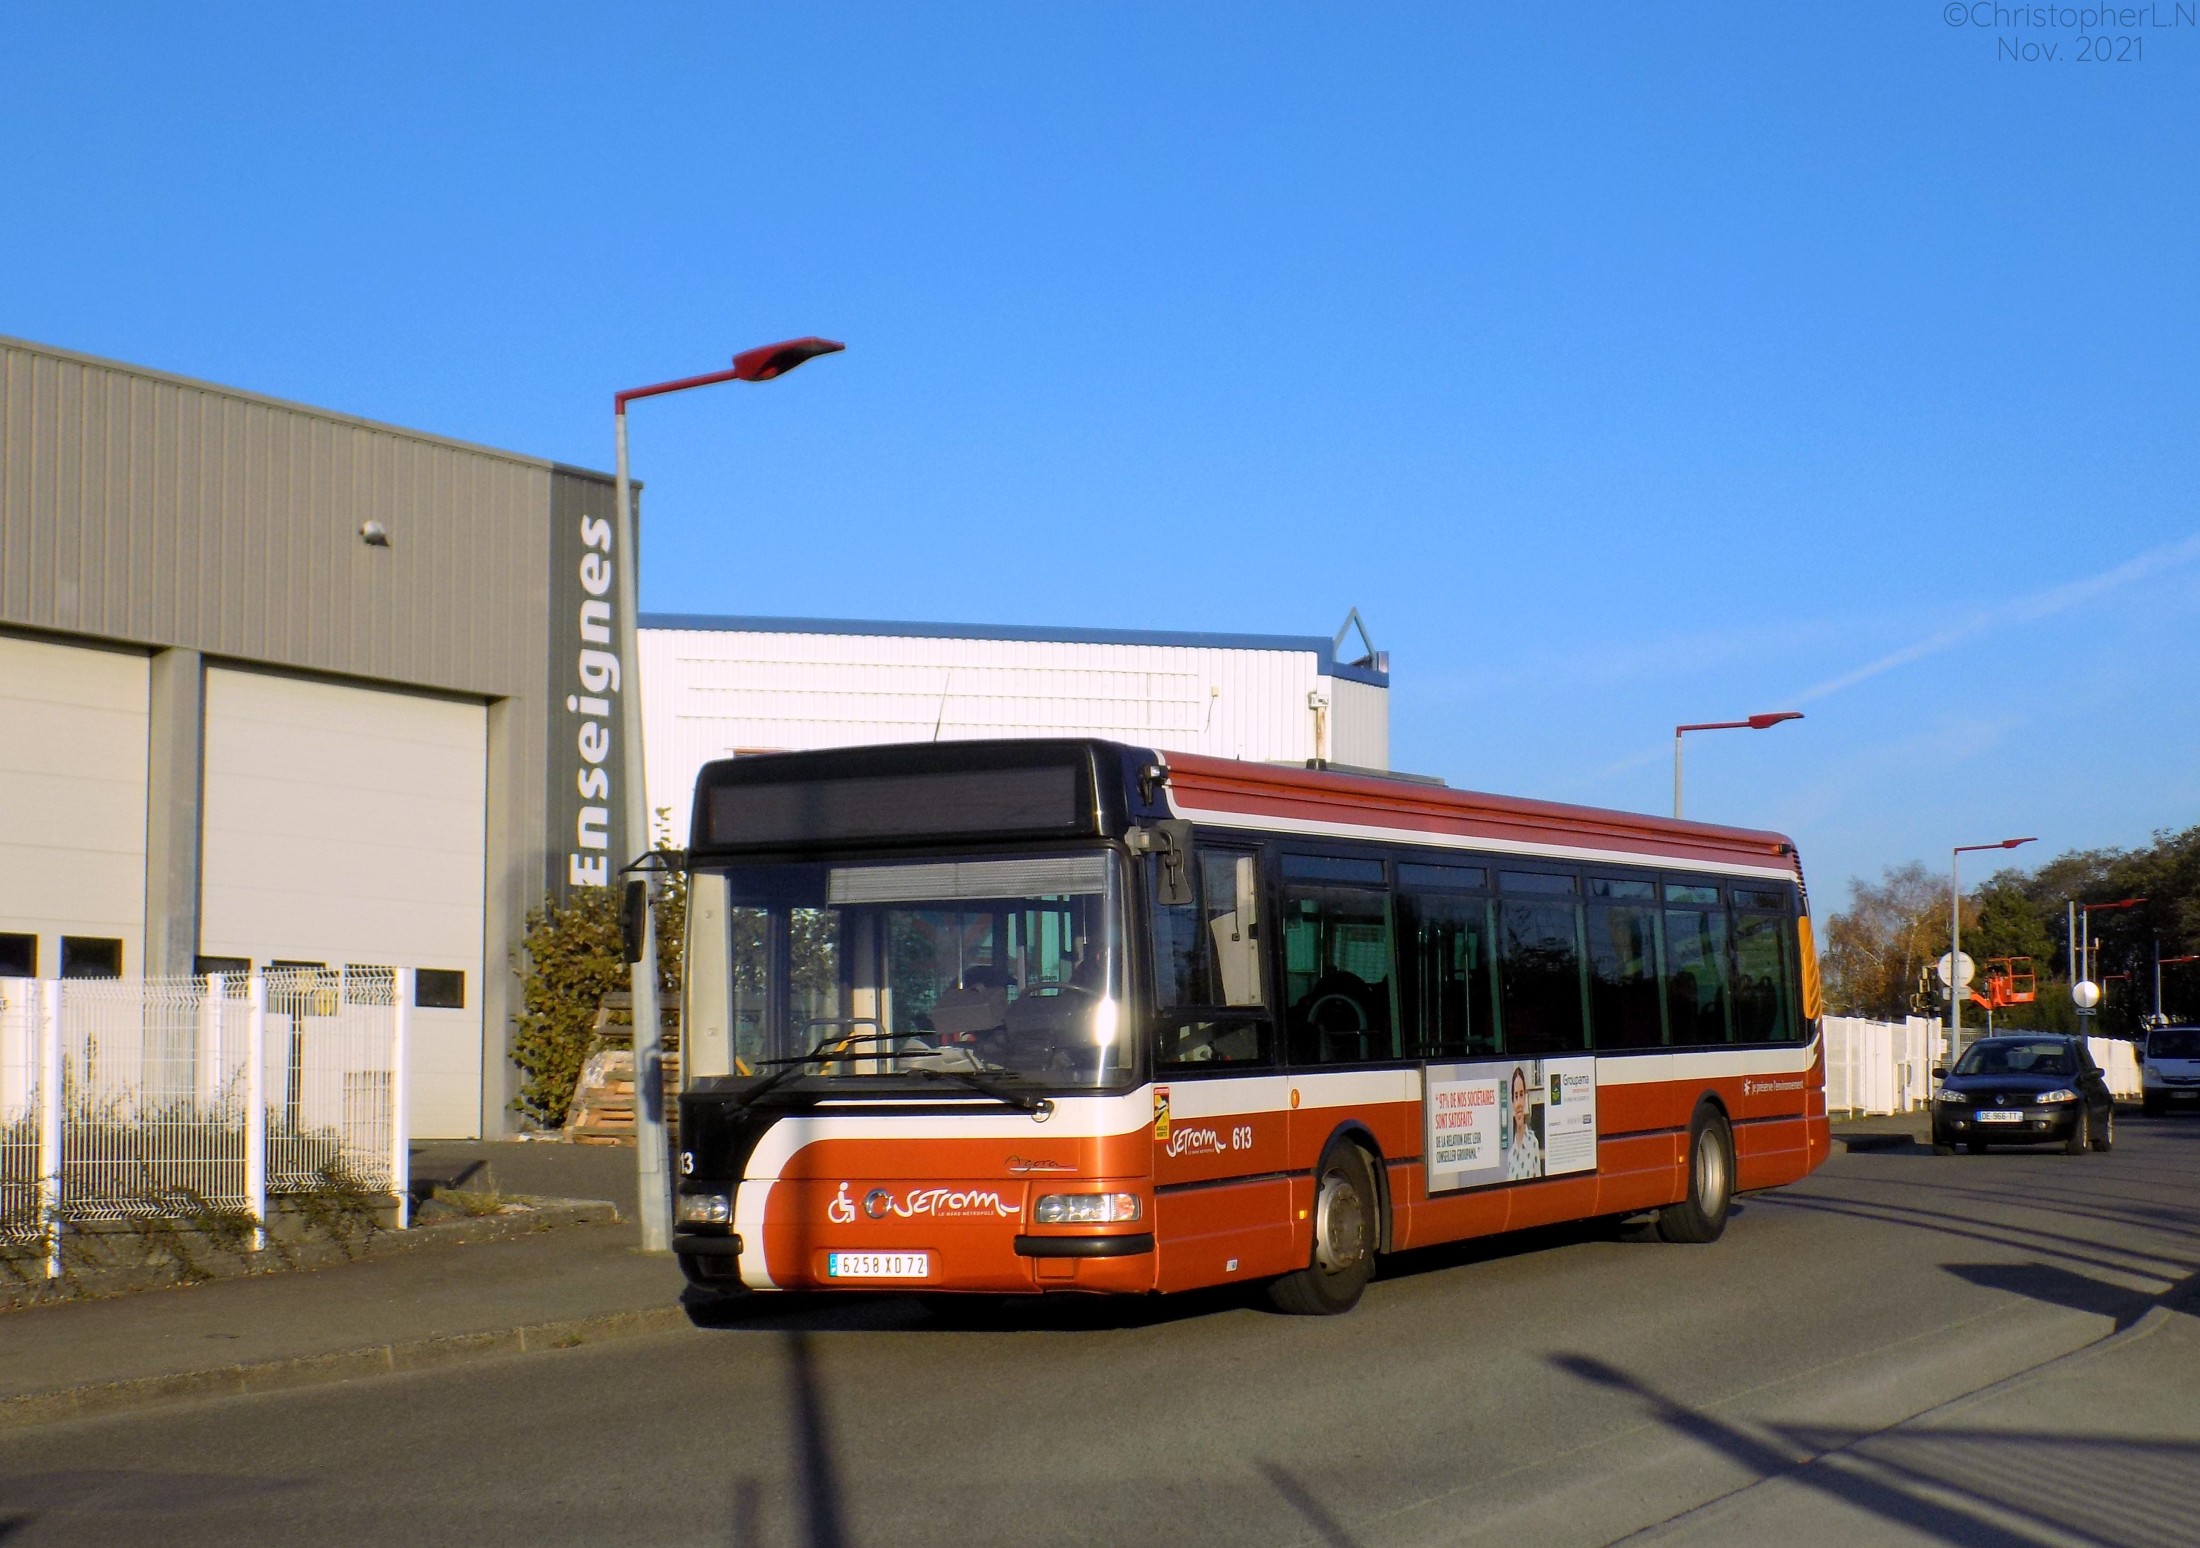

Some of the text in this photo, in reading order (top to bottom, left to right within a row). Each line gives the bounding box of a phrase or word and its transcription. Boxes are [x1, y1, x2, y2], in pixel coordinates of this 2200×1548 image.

[566, 514, 621, 888] Enseignes
[1562, 1074, 1589, 1087] Groupama
[1450, 1092, 1457, 1108] DE
[1457, 1091, 1467, 1108] NOS
[1435, 1111, 1473, 1130] SONT SATISFAITS
[1232, 1126, 1252, 1150] 613
[1004, 1155, 1077, 1173] Agora
[843, 1257, 924, 1273] 6258 XD 72
